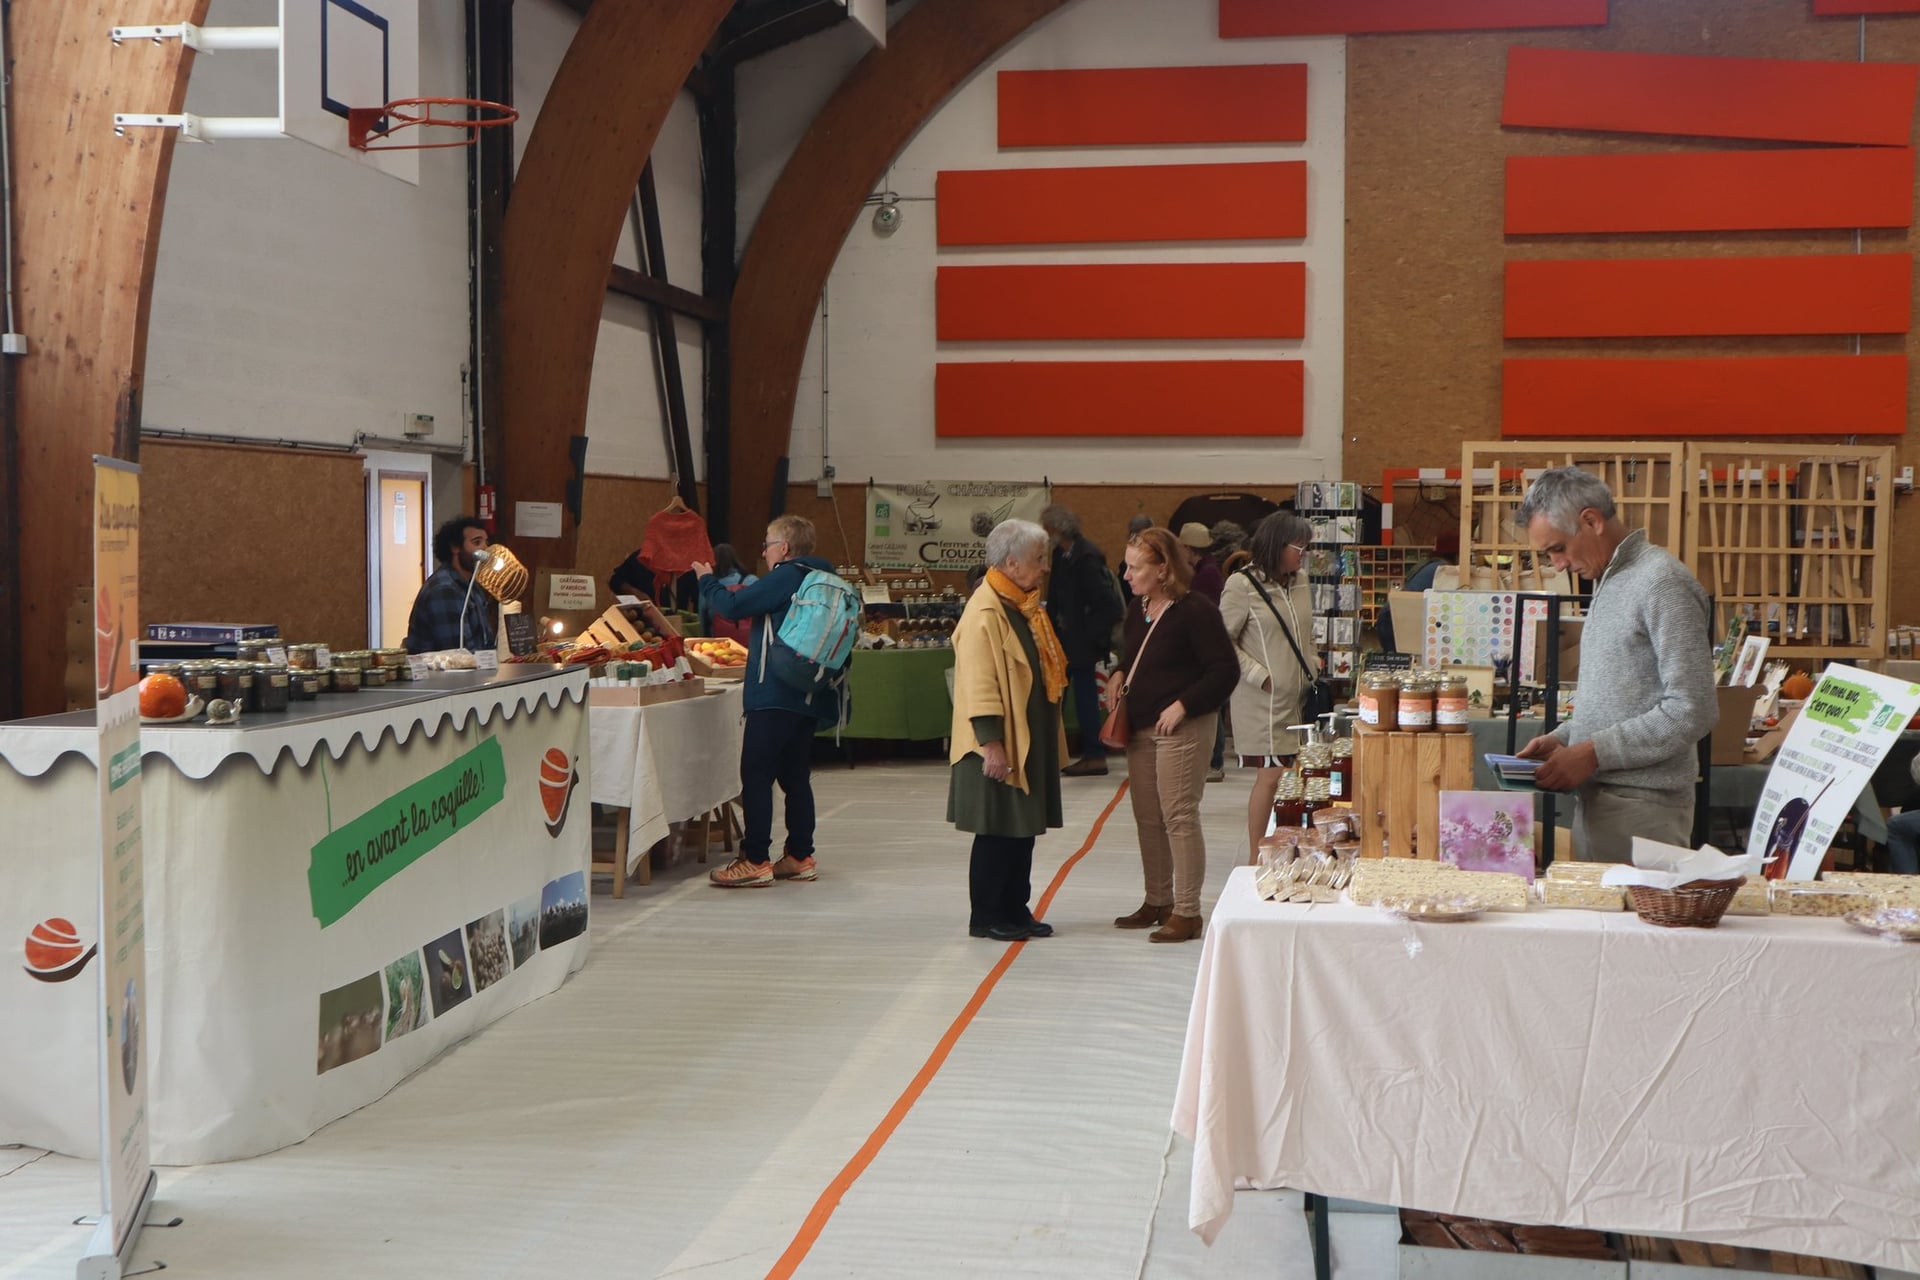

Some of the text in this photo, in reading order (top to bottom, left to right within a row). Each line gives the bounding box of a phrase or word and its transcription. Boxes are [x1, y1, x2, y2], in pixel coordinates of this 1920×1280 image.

[1820, 680, 1832, 695] Un
[1841, 706, 1851, 720] ?
[367, 808, 411, 866] avant
[411, 802, 431, 837] la
